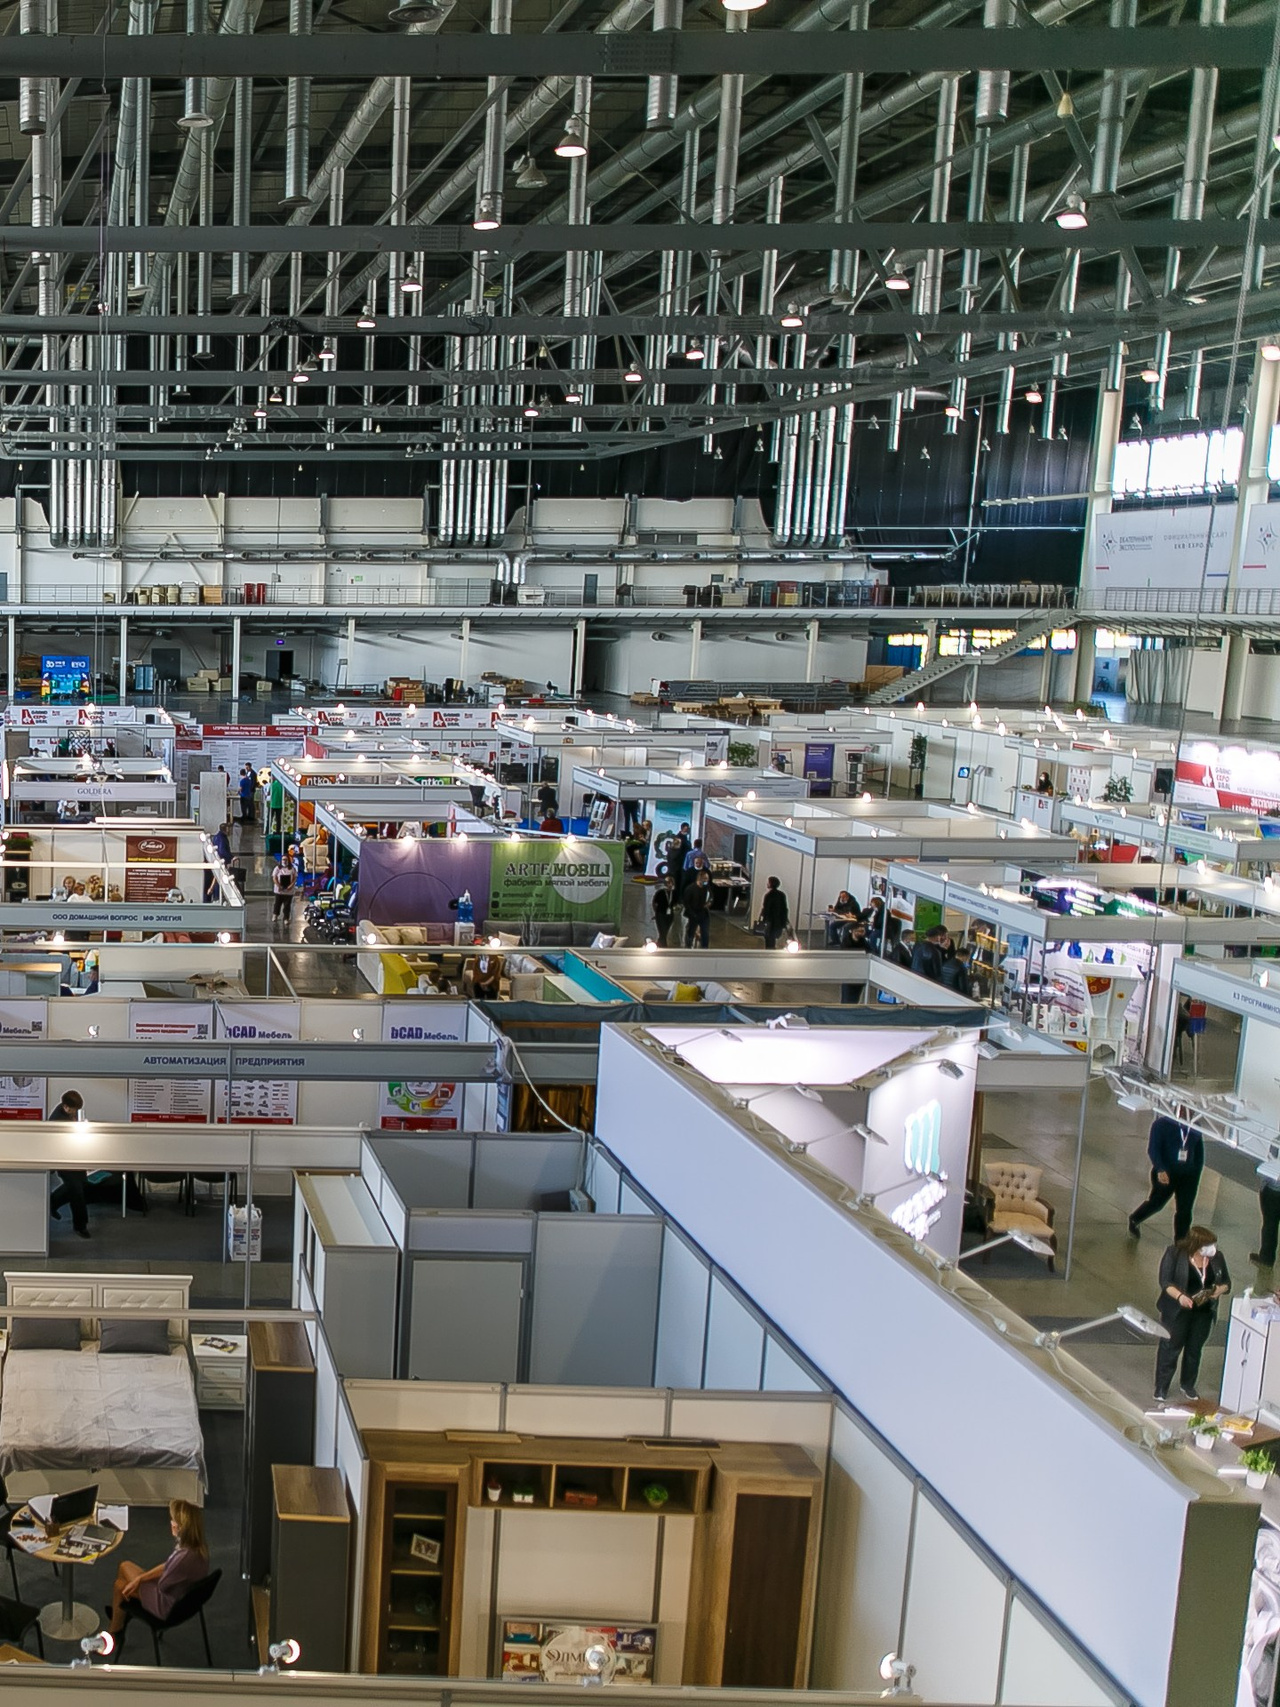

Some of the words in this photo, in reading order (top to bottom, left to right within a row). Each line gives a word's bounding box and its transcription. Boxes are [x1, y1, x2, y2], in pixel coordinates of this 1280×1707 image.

[504, 878, 543, 887] фабрика
[544, 879, 575, 887] мягкой
[577, 879, 610, 887] мебели
[69, 913, 109, 922] ДОМАШНИЙ
[258, 1031, 292, 1039] Мебель
[391, 1026, 423, 1040] bCAD
[424, 1032, 459, 1040] Мебель
[143, 1057, 227, 1066] АВТОМАТИЗАЦИЯ
[235, 1057, 305, 1067] ПРЕДПРИЯТИЯ
